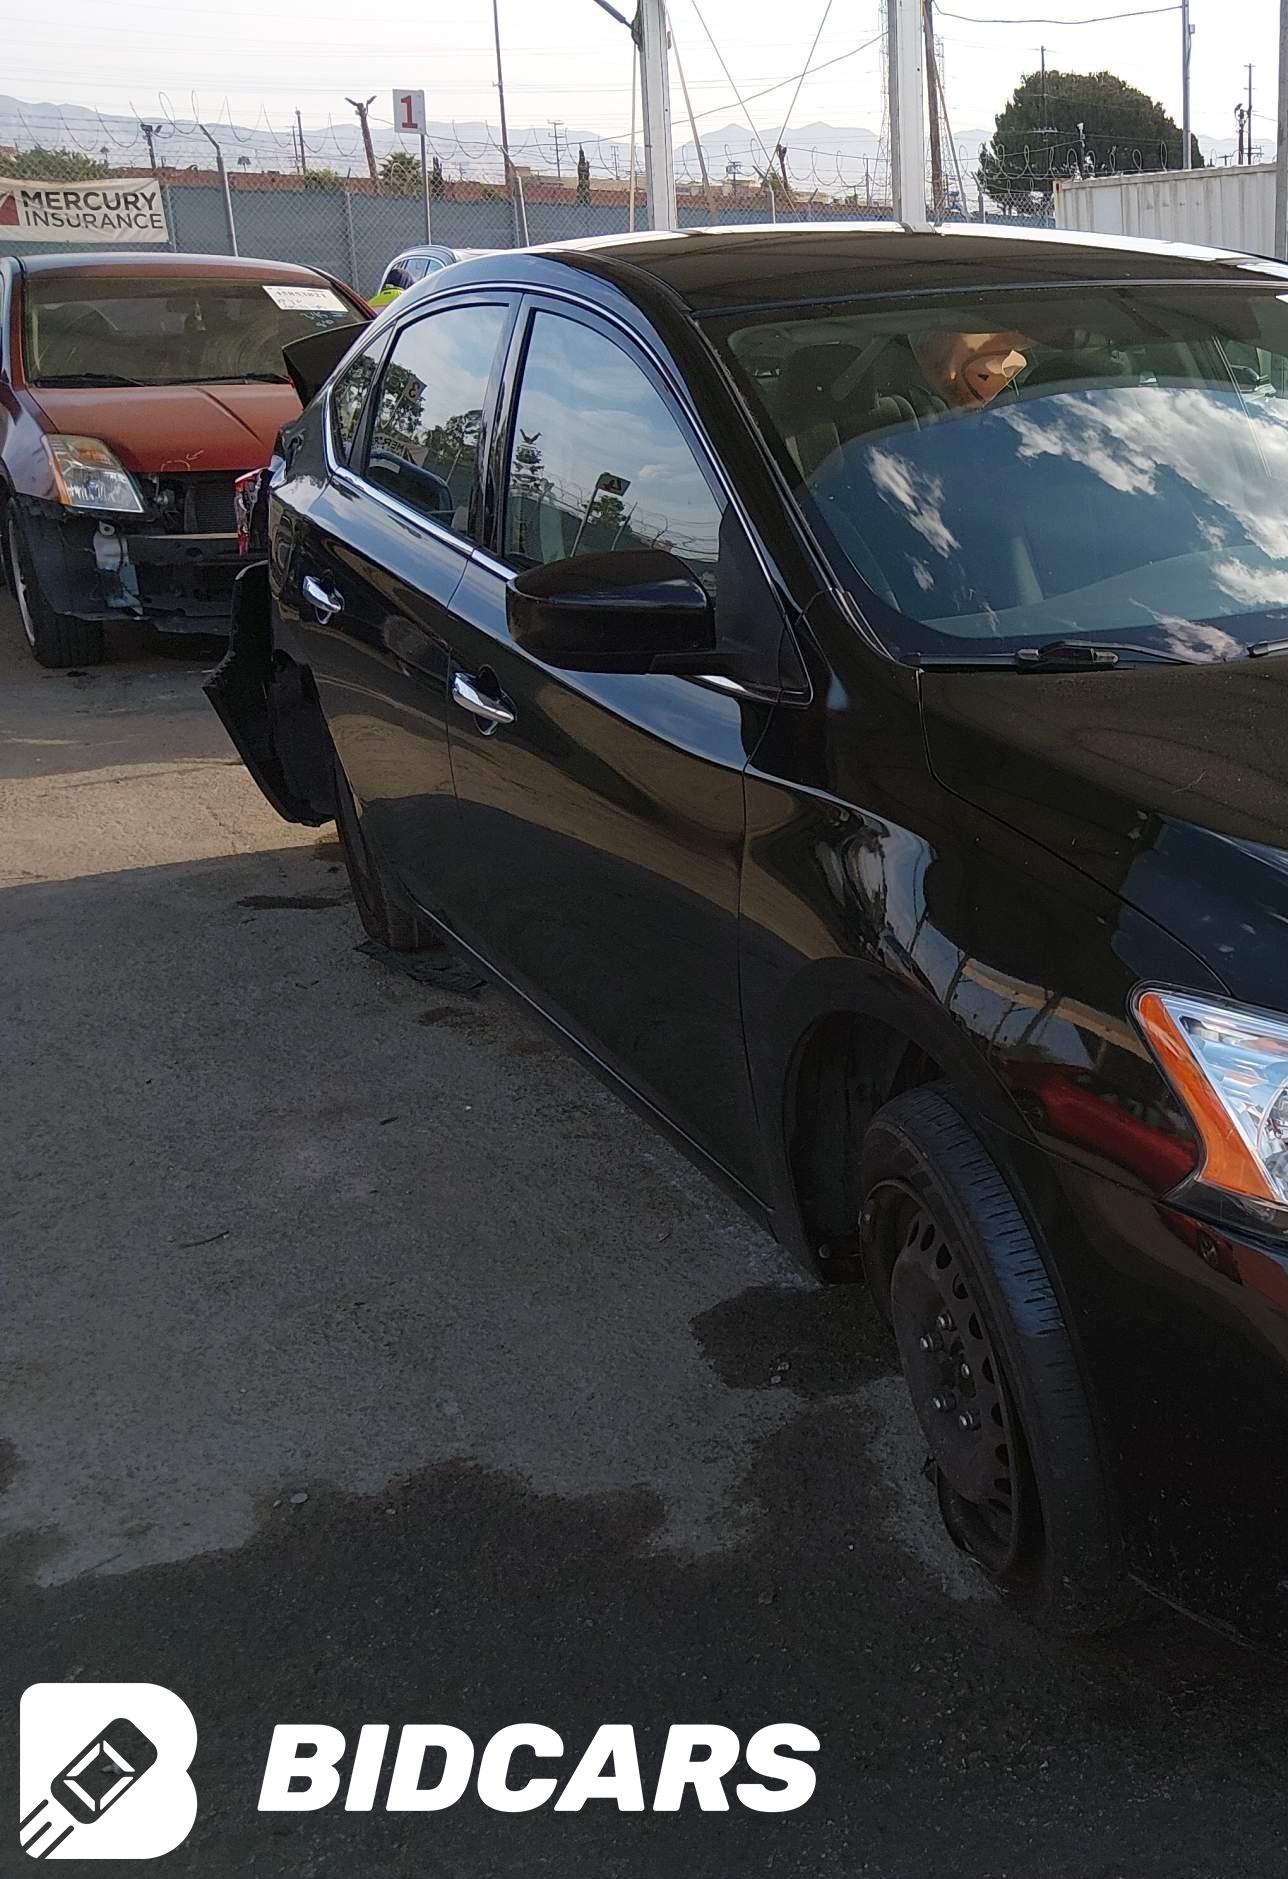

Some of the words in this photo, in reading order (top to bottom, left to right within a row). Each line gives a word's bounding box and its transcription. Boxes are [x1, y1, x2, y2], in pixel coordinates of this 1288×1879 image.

[401, 95, 418, 129] 1
[21, 190, 156, 211] MERCURY
[25, 211, 163, 229] INSURANCE
